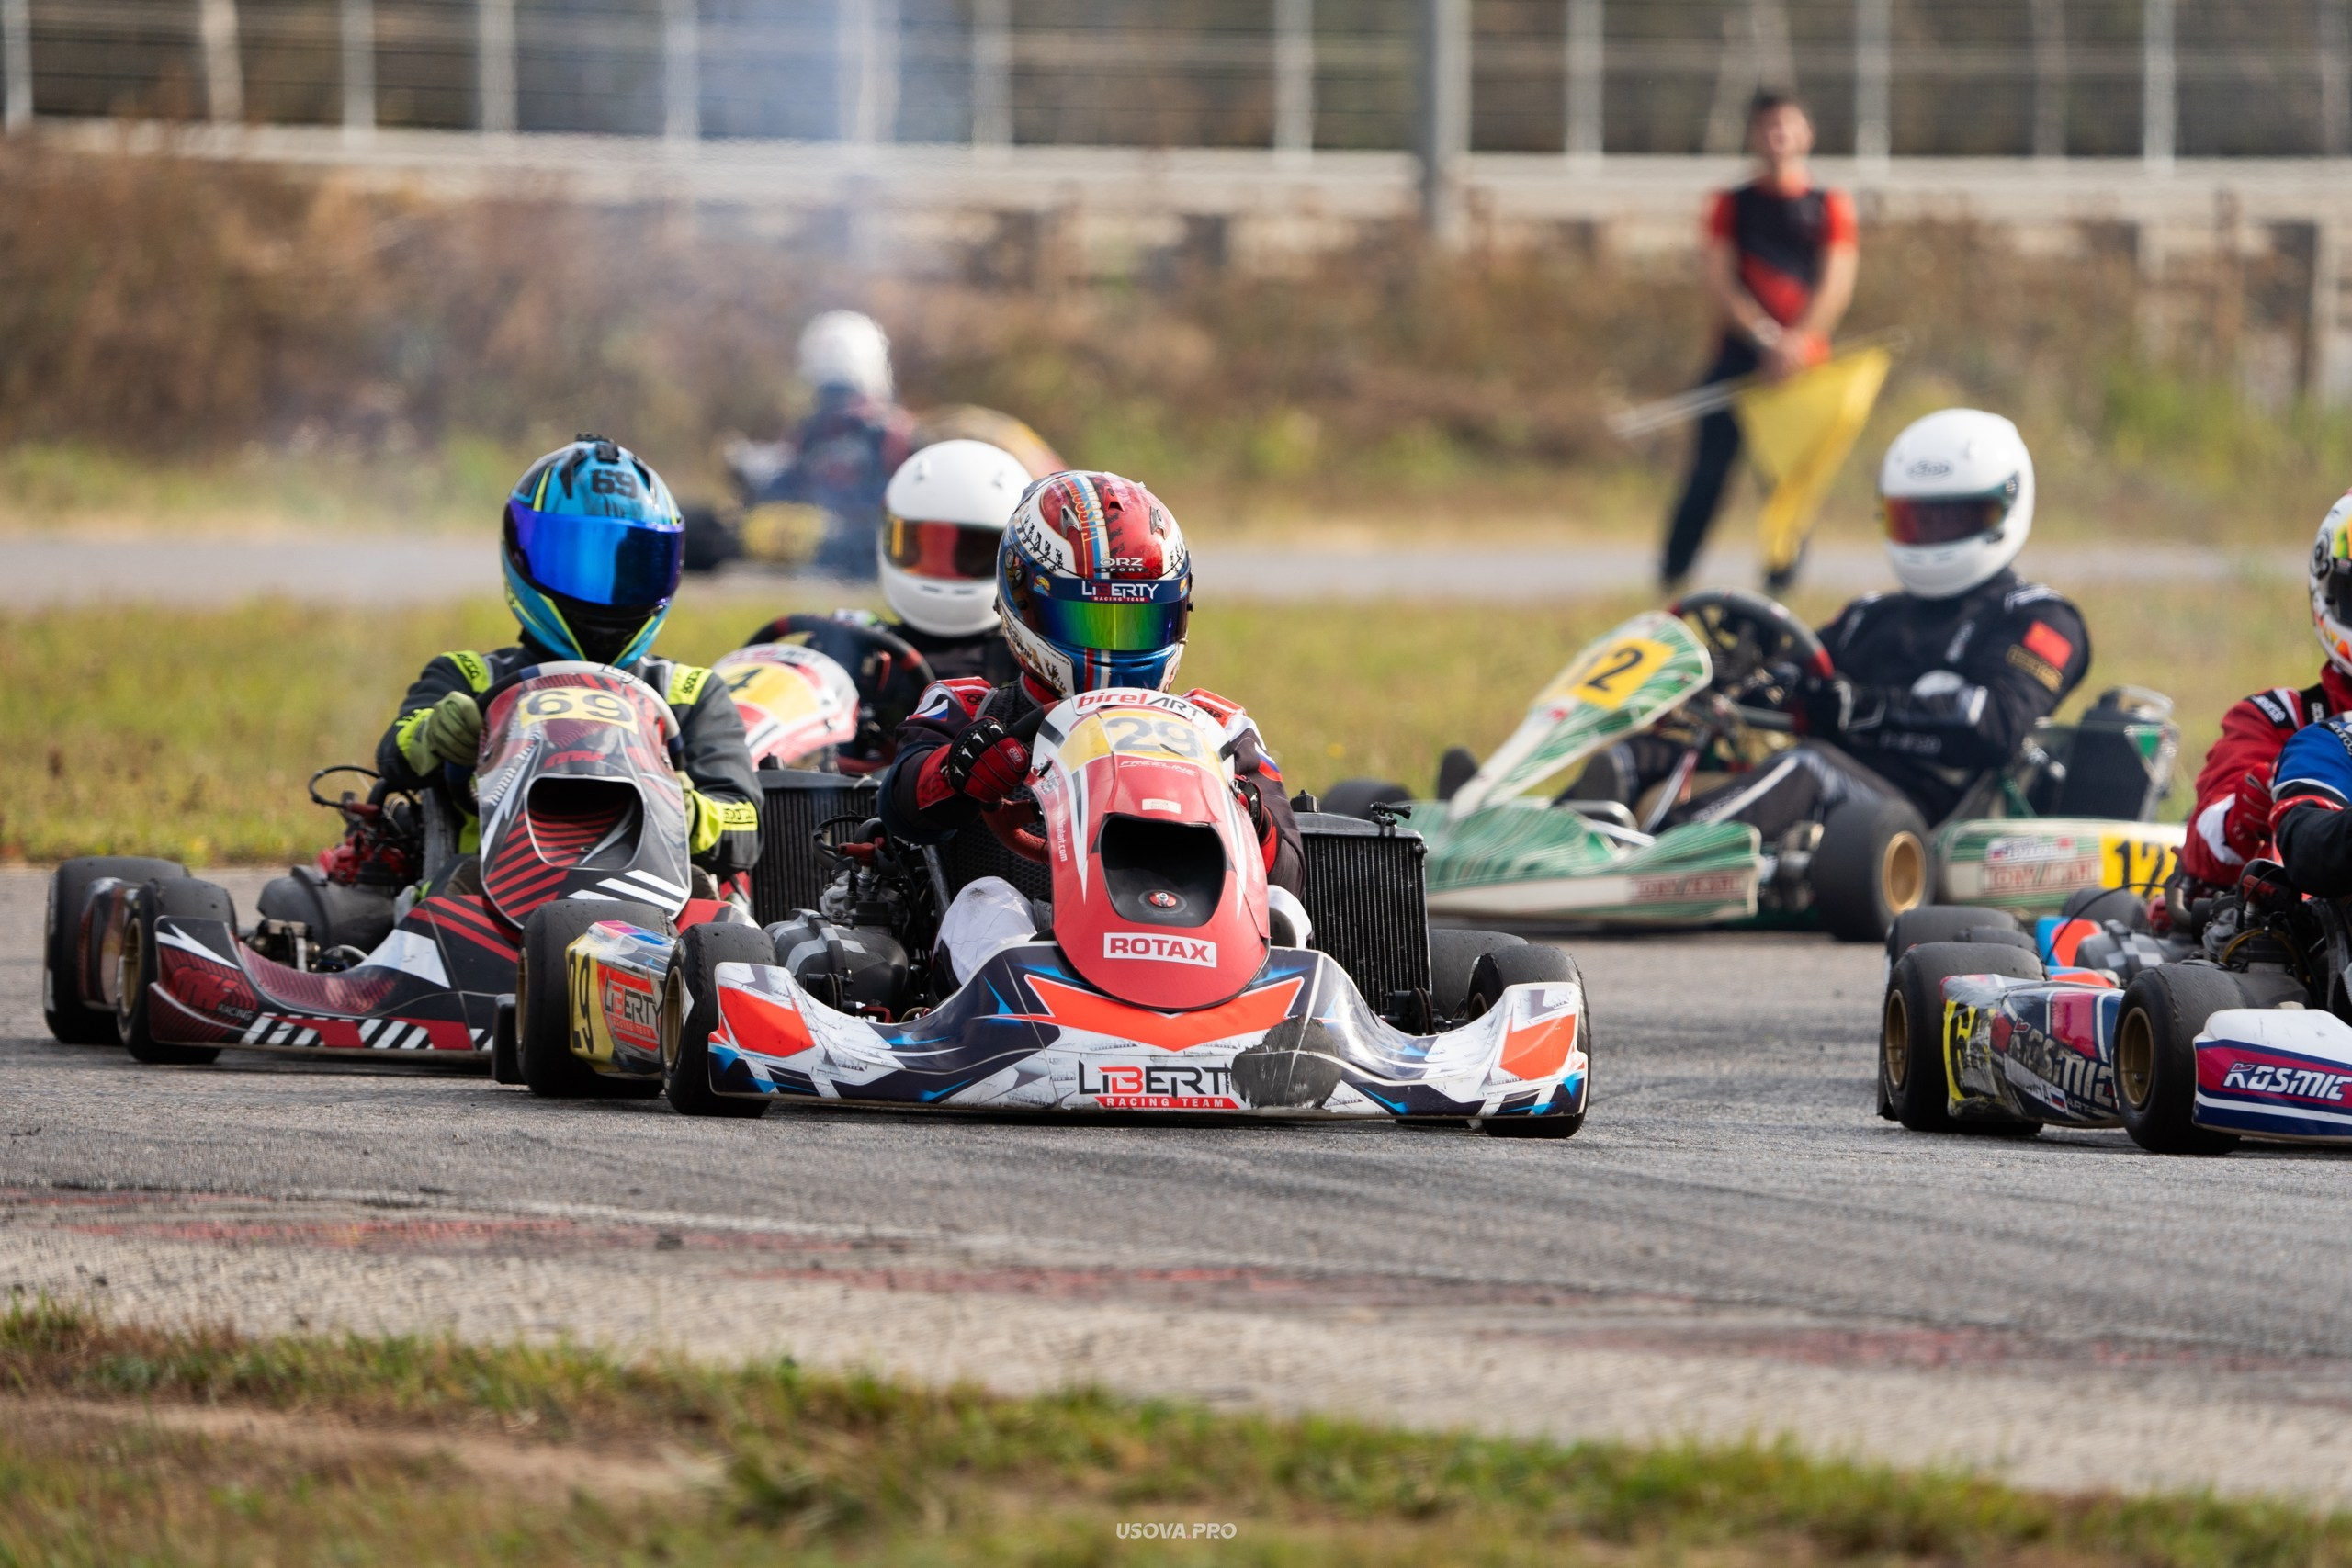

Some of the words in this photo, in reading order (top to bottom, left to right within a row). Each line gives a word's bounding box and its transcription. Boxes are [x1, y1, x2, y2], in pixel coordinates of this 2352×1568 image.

[591, 469, 638, 499] 69
[1100, 558, 1144, 567] ORZ
[526, 689, 633, 722] 69
[1105, 716, 1201, 759] 29
[1118, 760, 1198, 776] FREELINE
[2115, 840, 2165, 898] 12
[1109, 936, 1210, 963] ROTAX
[216, 1002, 255, 1021] RACING
[568, 948, 595, 1055] 29
[612, 1017, 634, 1032] RACING
[1078, 1059, 1233, 1100] LIBERT
[2222, 1062, 2352, 1101] KOSMIC
[1106, 1097, 1170, 1108] RACING
[1182, 1098, 1224, 1108] TEAM
